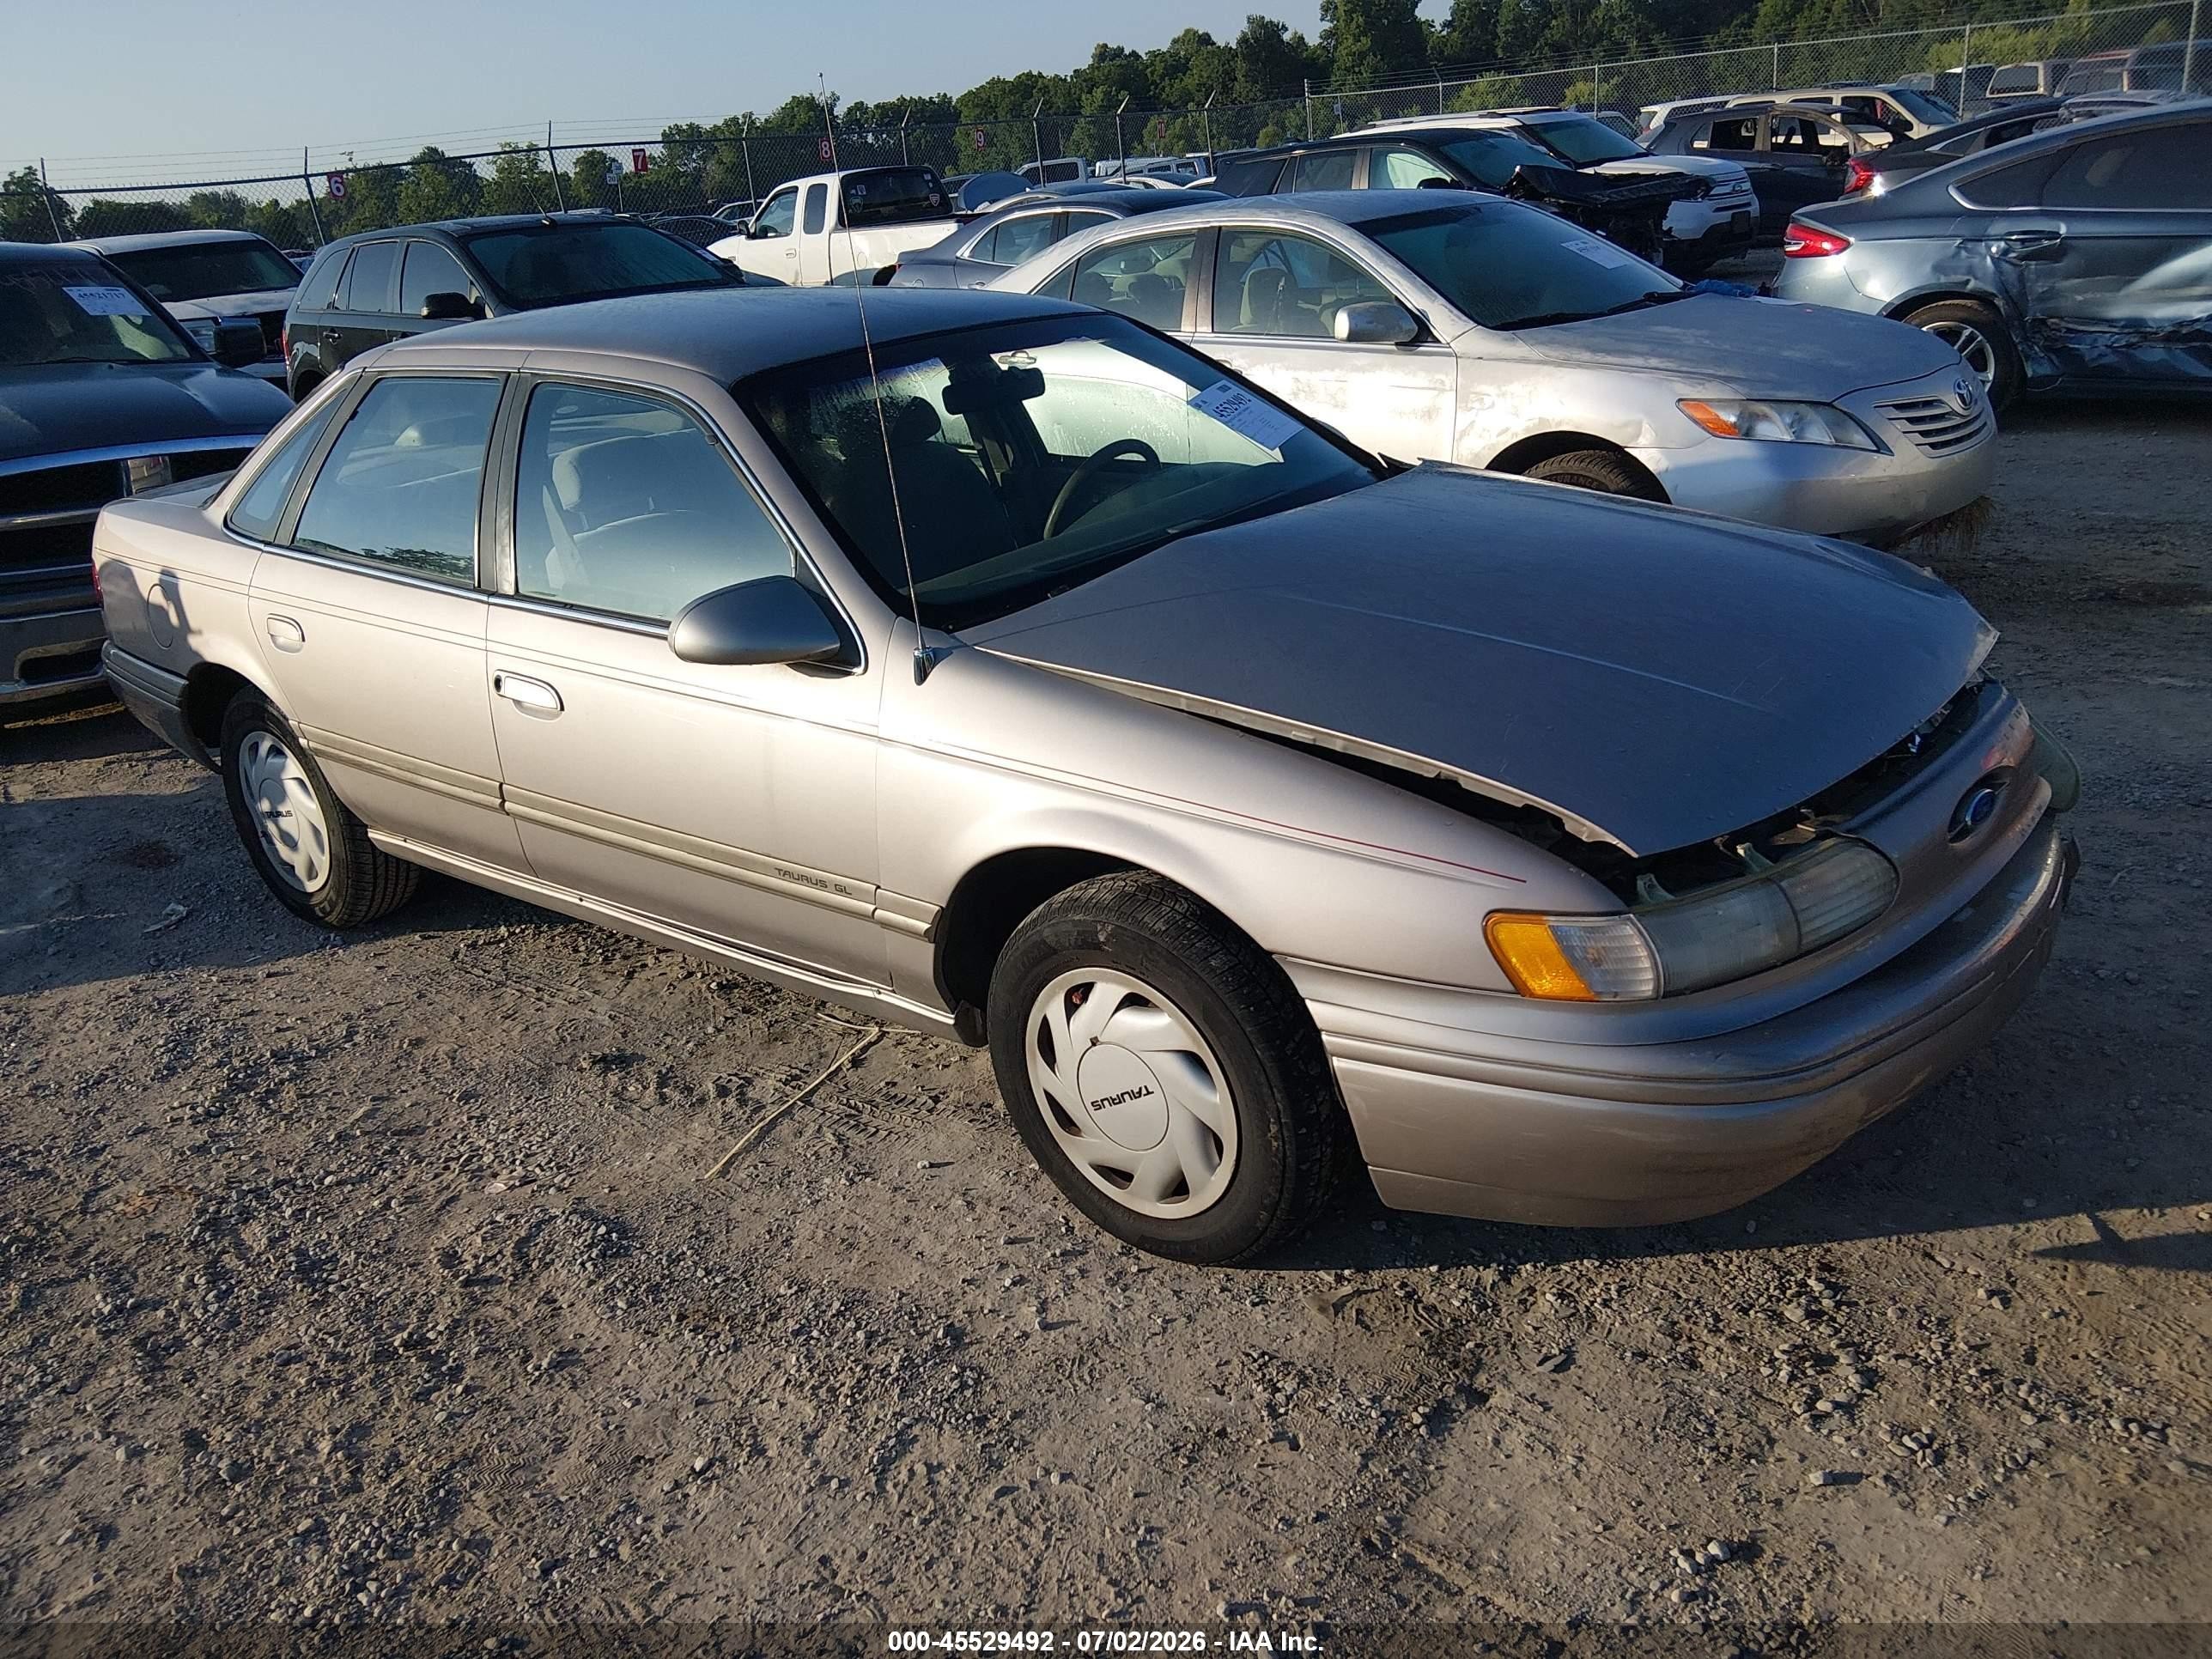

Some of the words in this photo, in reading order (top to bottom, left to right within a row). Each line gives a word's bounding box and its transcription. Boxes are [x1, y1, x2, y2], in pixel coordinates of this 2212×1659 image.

[977, 131, 984, 146] 9
[822, 141, 830, 158] 8
[634, 151, 644, 169] 7
[331, 177, 344, 196] 6
[1212, 392, 1252, 418] 45529492
[264, 810, 294, 818] TAURUS
[774, 867, 828, 889] TAURUS
[834, 884, 853, 895] GL
[1091, 1085, 1155, 1111] TAURUS
